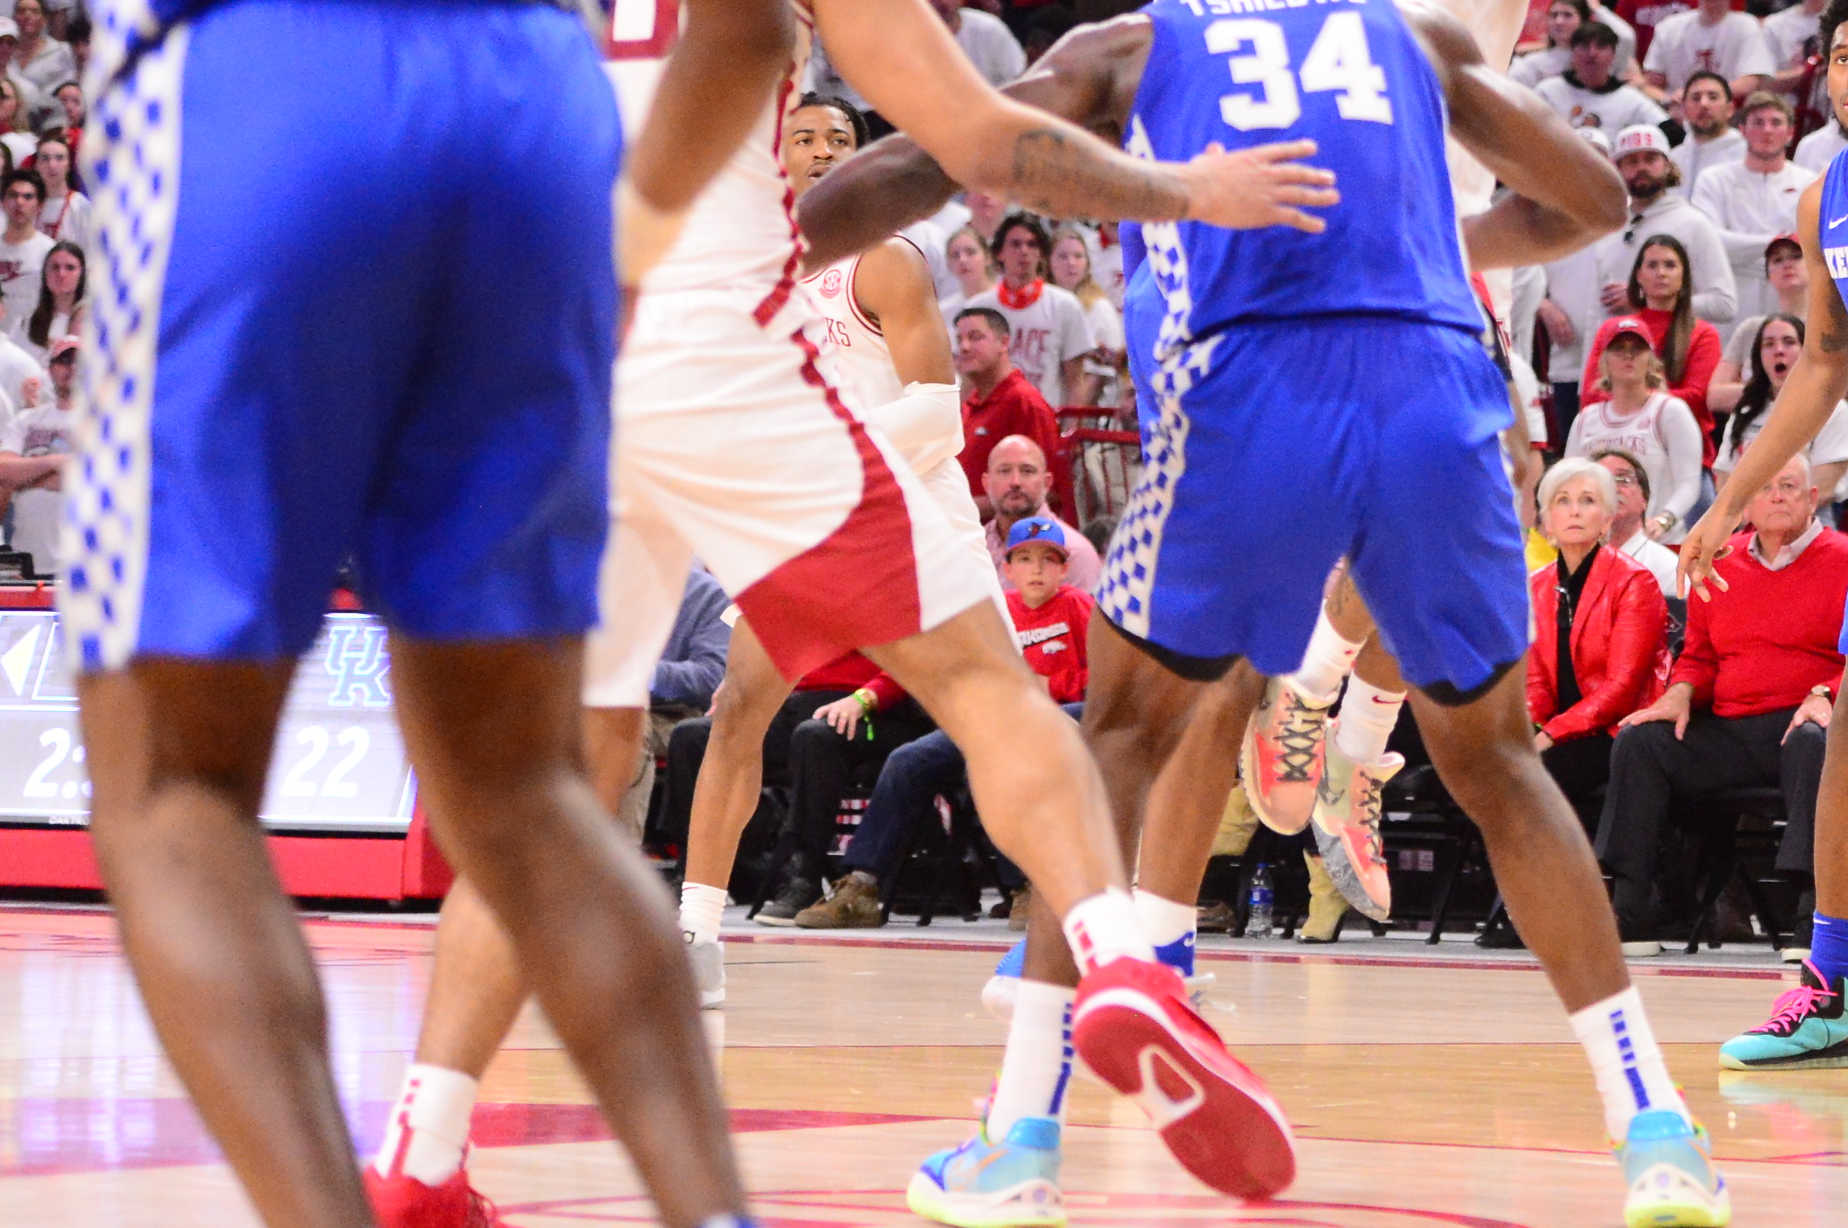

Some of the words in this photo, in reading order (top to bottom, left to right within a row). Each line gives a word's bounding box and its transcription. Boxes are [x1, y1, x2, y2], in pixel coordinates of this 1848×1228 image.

[1203, 11, 1394, 132] 34
[23, 727, 92, 800] 2:
[280, 725, 371, 798] 22
